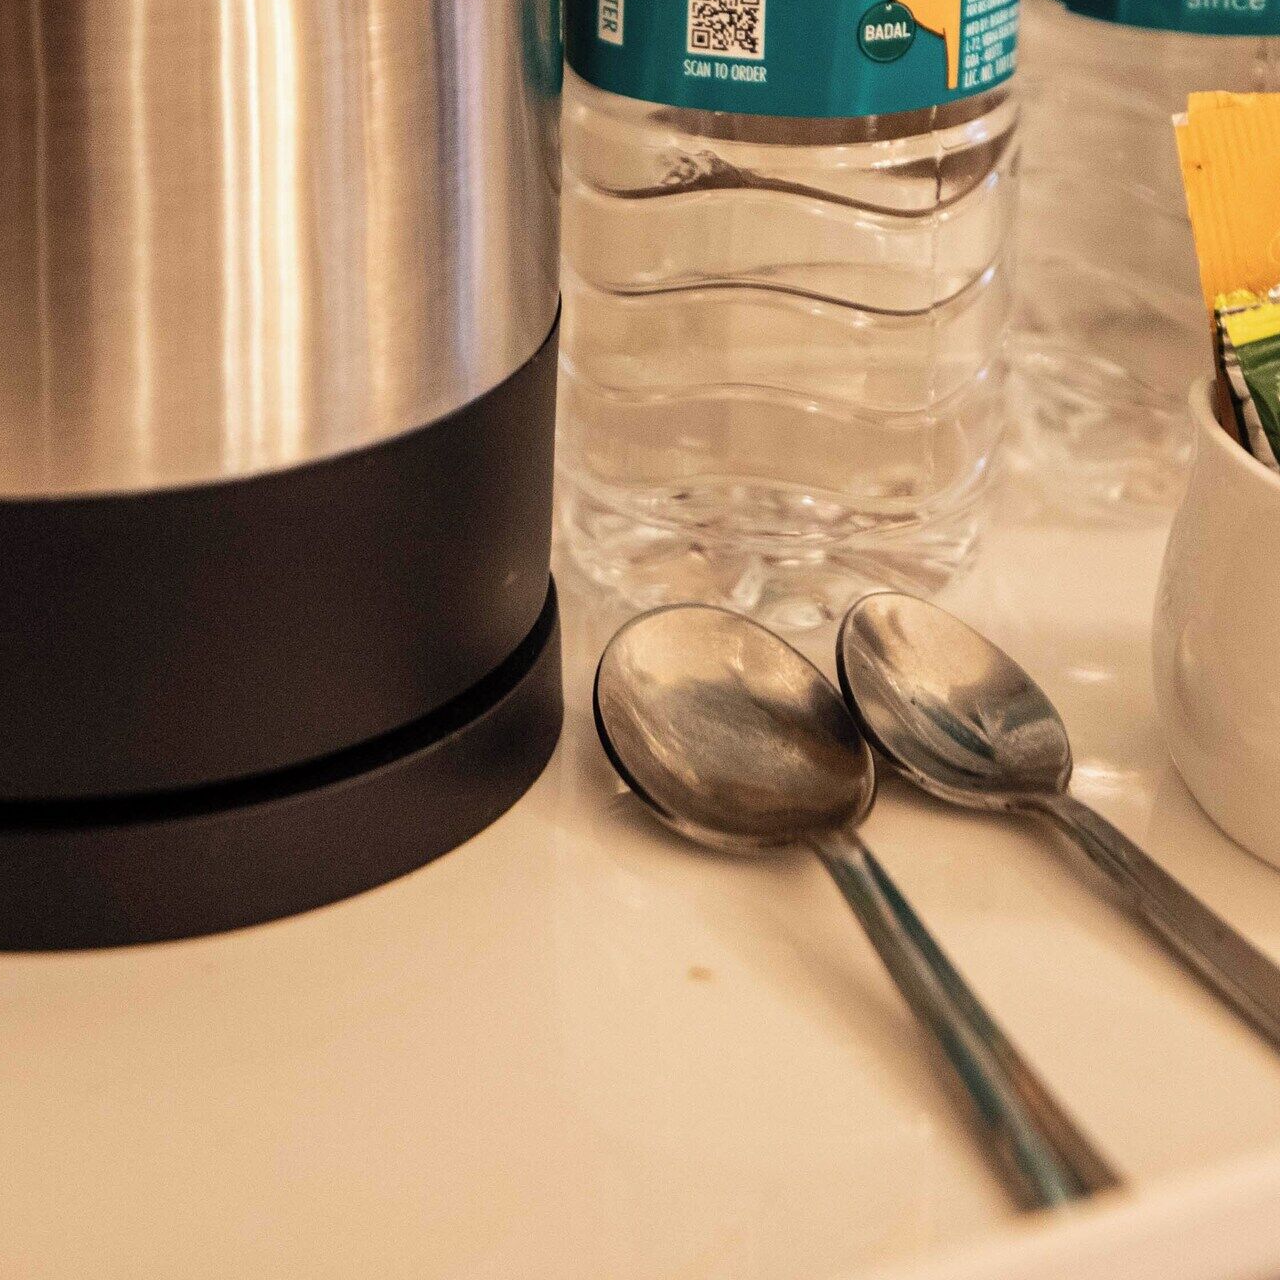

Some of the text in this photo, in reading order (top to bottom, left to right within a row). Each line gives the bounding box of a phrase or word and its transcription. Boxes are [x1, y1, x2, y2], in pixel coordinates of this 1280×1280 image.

[864, 21, 911, 42] BADAL
[683, 59, 768, 83] SCAN TO ORDER
